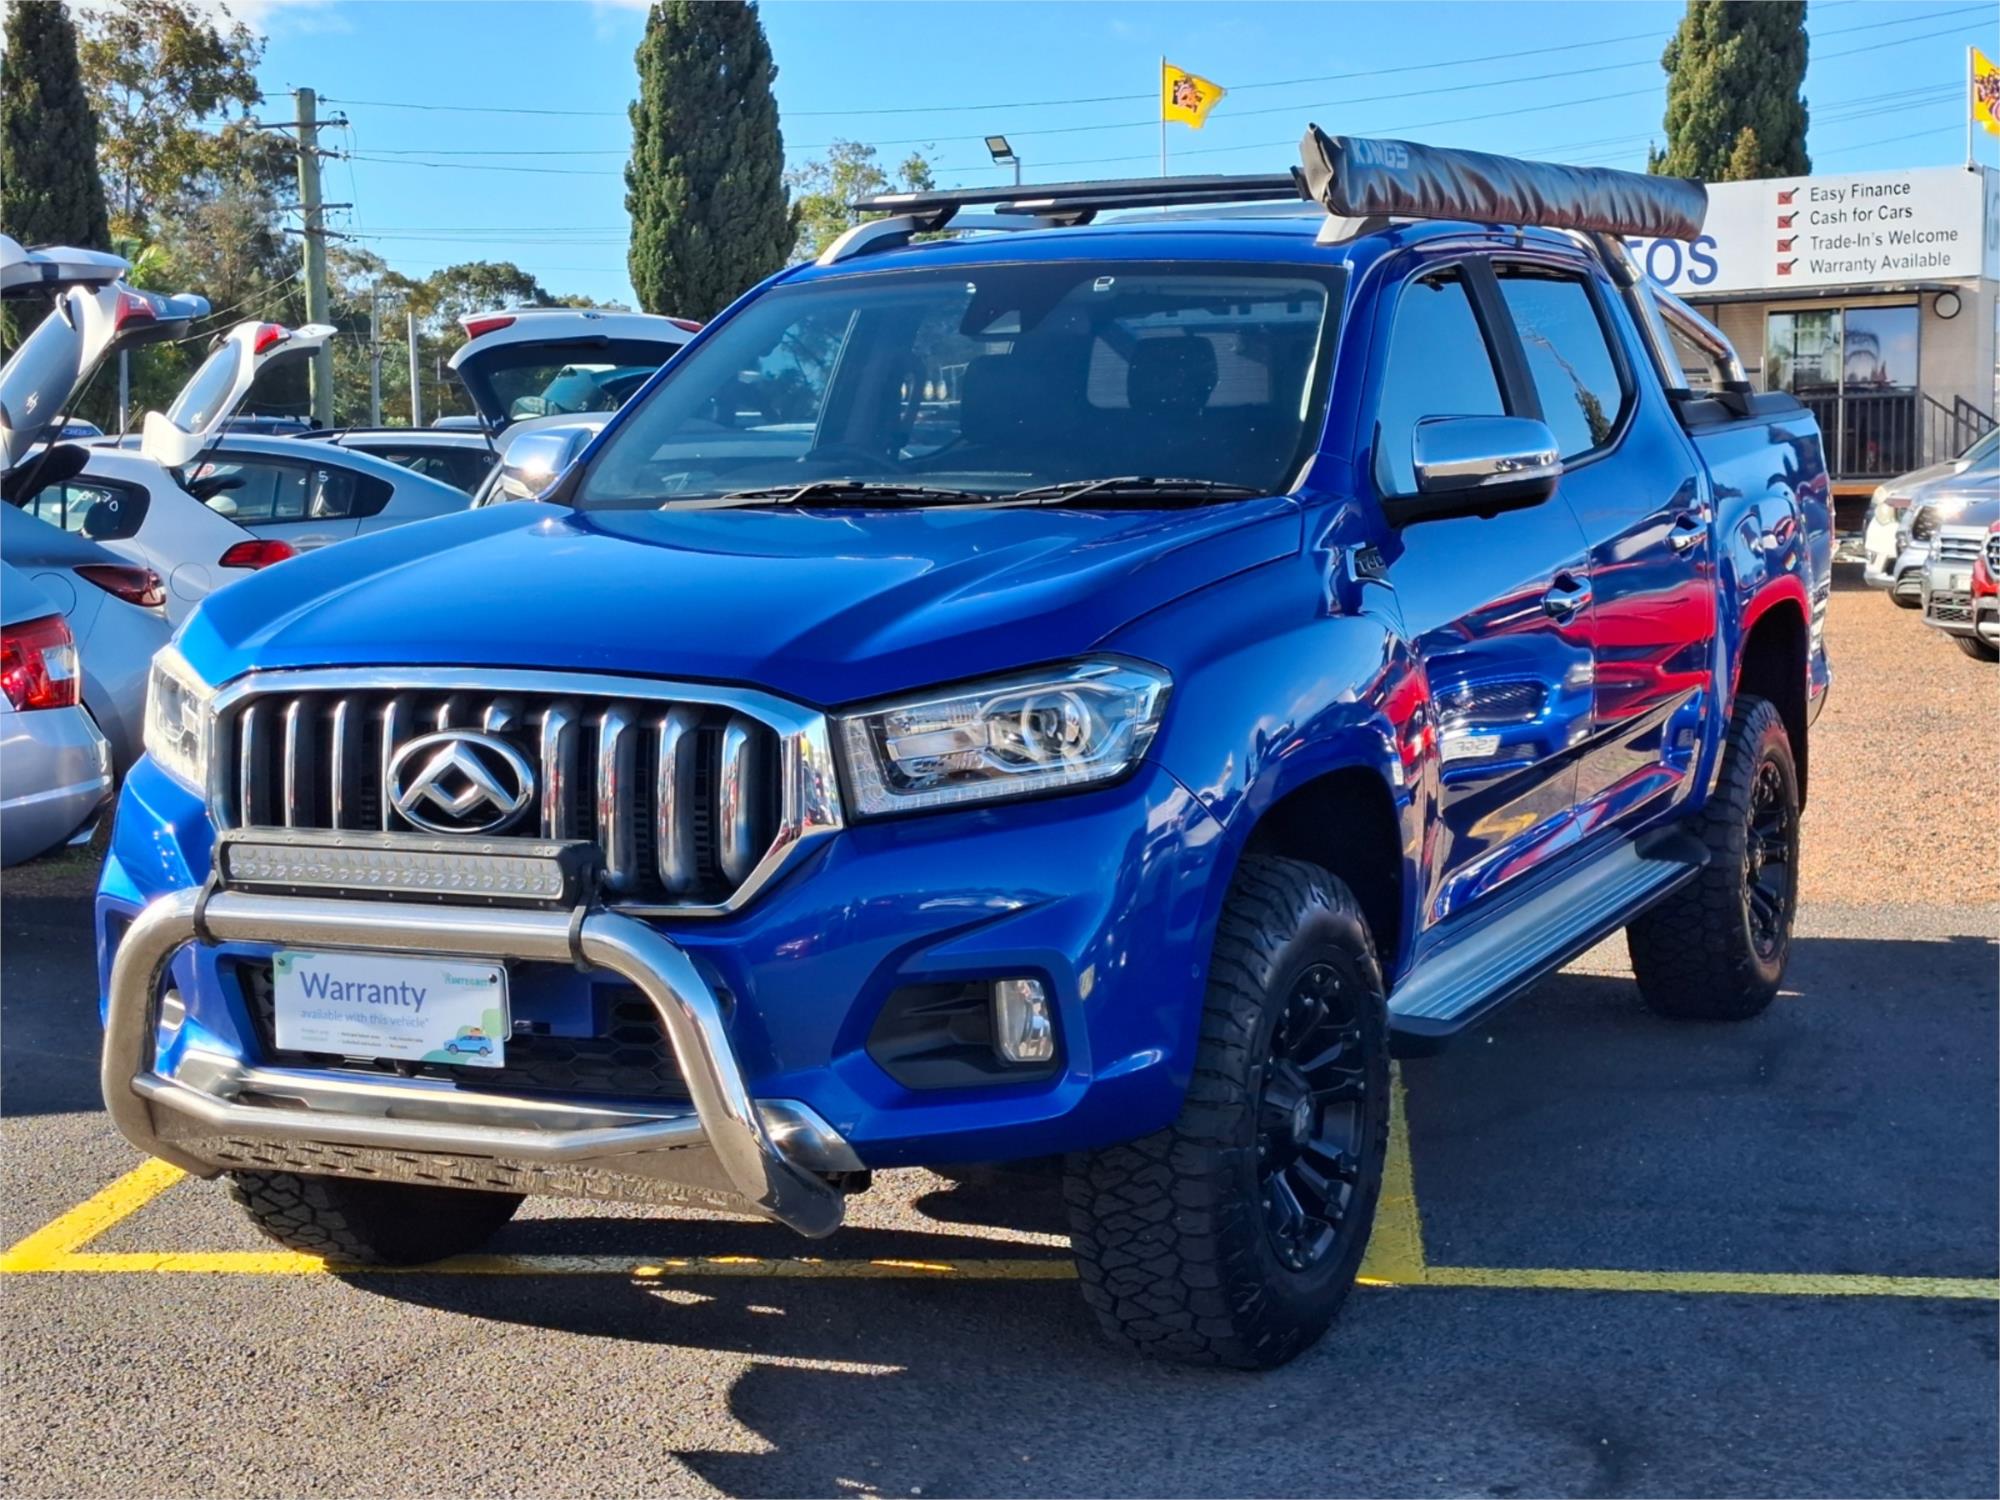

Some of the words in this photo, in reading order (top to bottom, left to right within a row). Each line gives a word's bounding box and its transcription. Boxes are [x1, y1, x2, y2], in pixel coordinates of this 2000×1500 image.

[1351, 138, 1409, 169] KINGS
[1810, 186, 1846, 204] Easy
[1851, 182, 1911, 198] Finance
[1810, 209, 1848, 226] Cash
[1852, 207, 1873, 223] for
[1878, 205, 1913, 221] Cars
[1810, 232, 1883, 251] Trade-In's
[1888, 229, 1958, 246] Welcome
[1810, 257, 1877, 278] Warranty
[1881, 252, 1951, 269] Available
[299, 971, 427, 1013] Warranty
[301, 1009, 342, 1022] available
[345, 1011, 368, 1024] with
[370, 1013, 388, 1025] this
